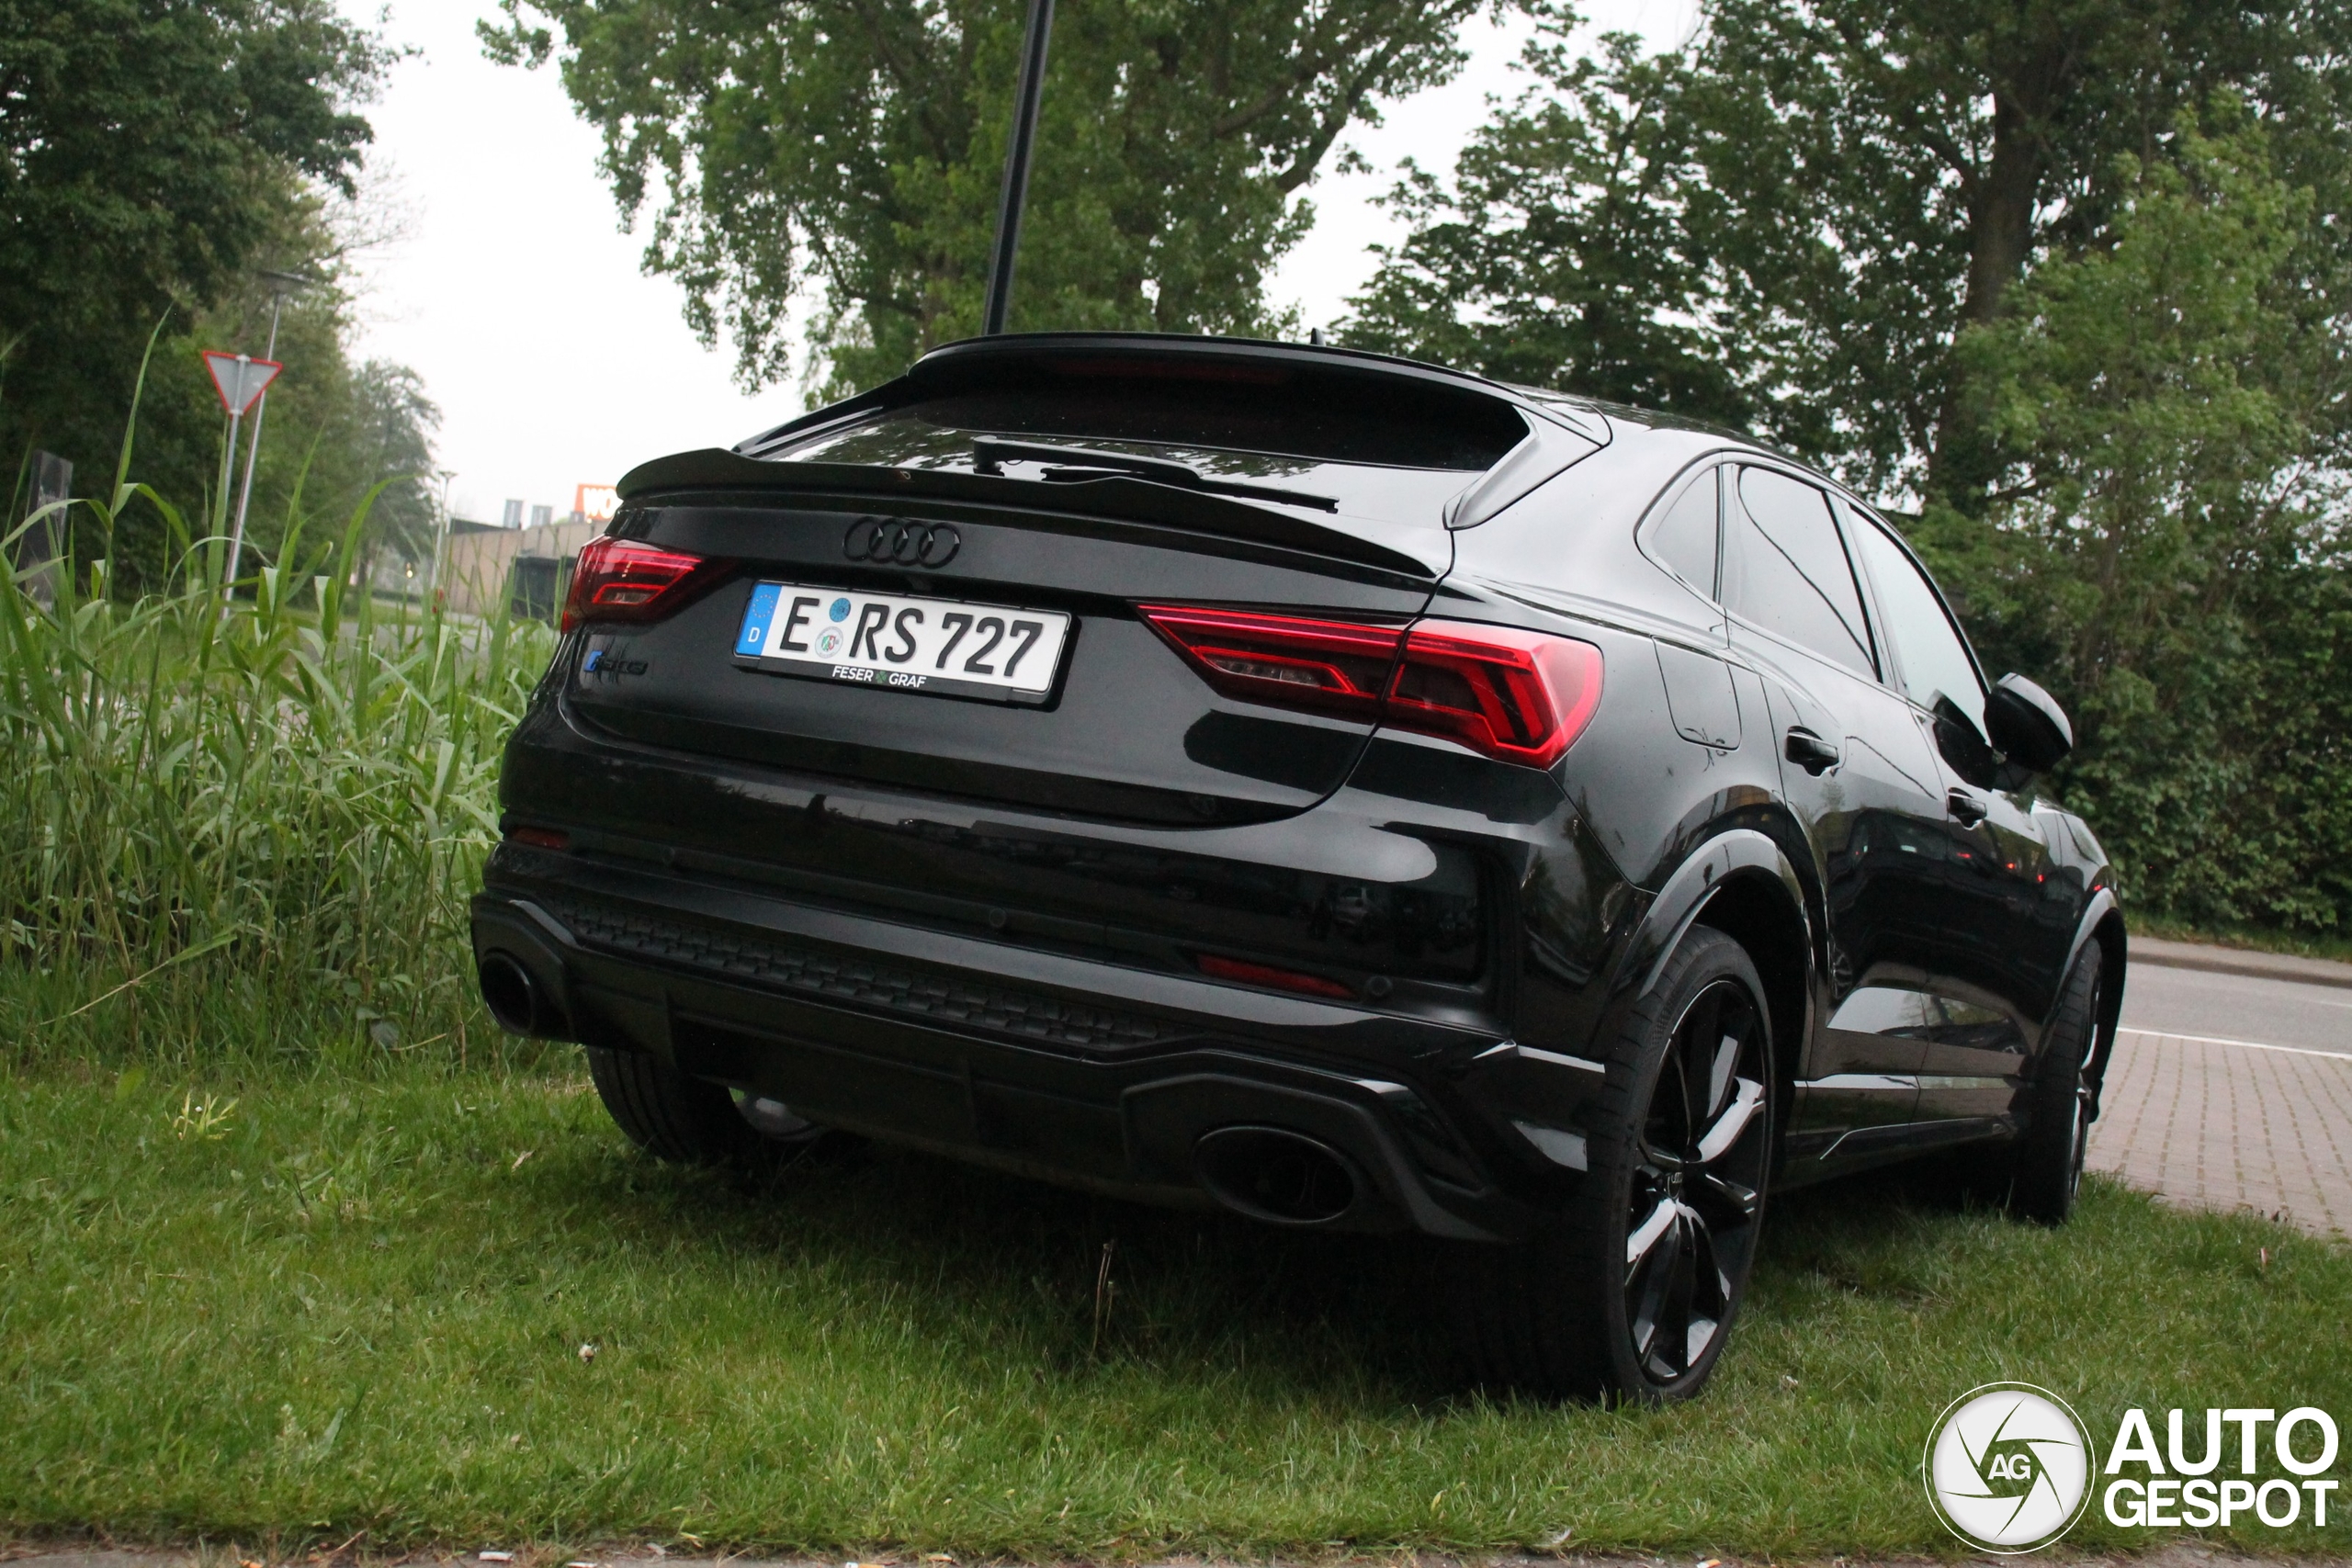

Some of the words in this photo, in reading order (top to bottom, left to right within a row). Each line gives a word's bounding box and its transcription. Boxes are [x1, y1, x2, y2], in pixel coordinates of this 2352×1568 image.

[747, 626, 761, 643] D
[780, 596, 820, 652] E
[849, 603, 923, 663] RS
[935, 612, 1043, 677] 727
[831, 665, 874, 682] FESER
[888, 672, 927, 688] GRAF
